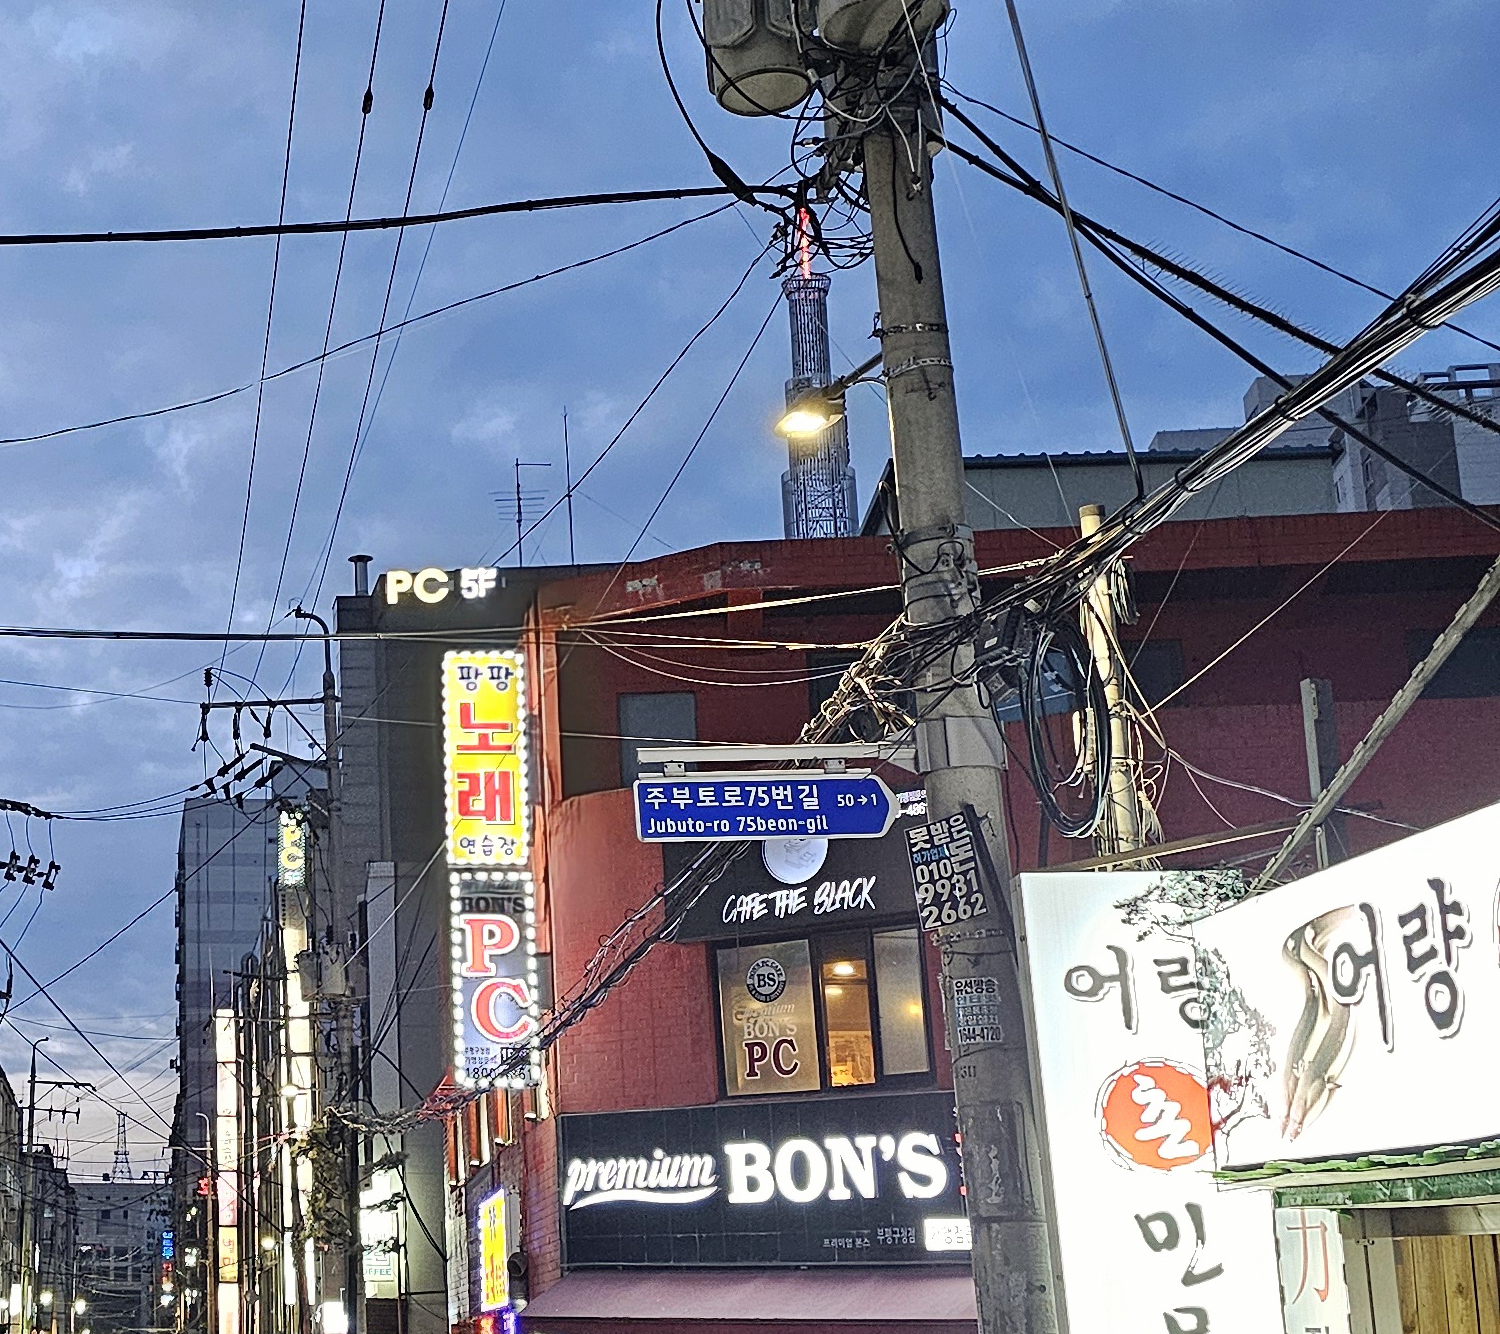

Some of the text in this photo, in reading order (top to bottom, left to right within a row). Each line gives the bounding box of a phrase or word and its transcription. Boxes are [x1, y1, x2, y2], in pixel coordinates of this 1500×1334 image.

[386, 568, 498, 605] PC 5F
[456, 702, 516, 825] 노래
[645, 784, 820, 810] 주부토로75번길
[647, 815, 829, 834] Jubuto-ro 75beon-gil
[459, 835, 517, 856] 연습장
[916, 859, 953, 883] 010
[722, 876, 877, 924] CAFE THE BLACK
[918, 870, 979, 906] 9931
[461, 897, 526, 913] BON'S
[921, 893, 987, 929] 2662
[1332, 878, 1470, 1052] 어량
[460, 914, 533, 1044] PC
[756, 972, 777, 988] BS
[955, 979, 996, 995] 유선방송
[743, 1017, 798, 1039] BON'S
[958, 1027, 1001, 1042] 1644-4720
[743, 1037, 800, 1079] PC
[562, 1132, 948, 1210] premium BON'S
[823, 1238, 853, 1249] 프리미엄
[877, 1228, 916, 1244] 부평구청점
